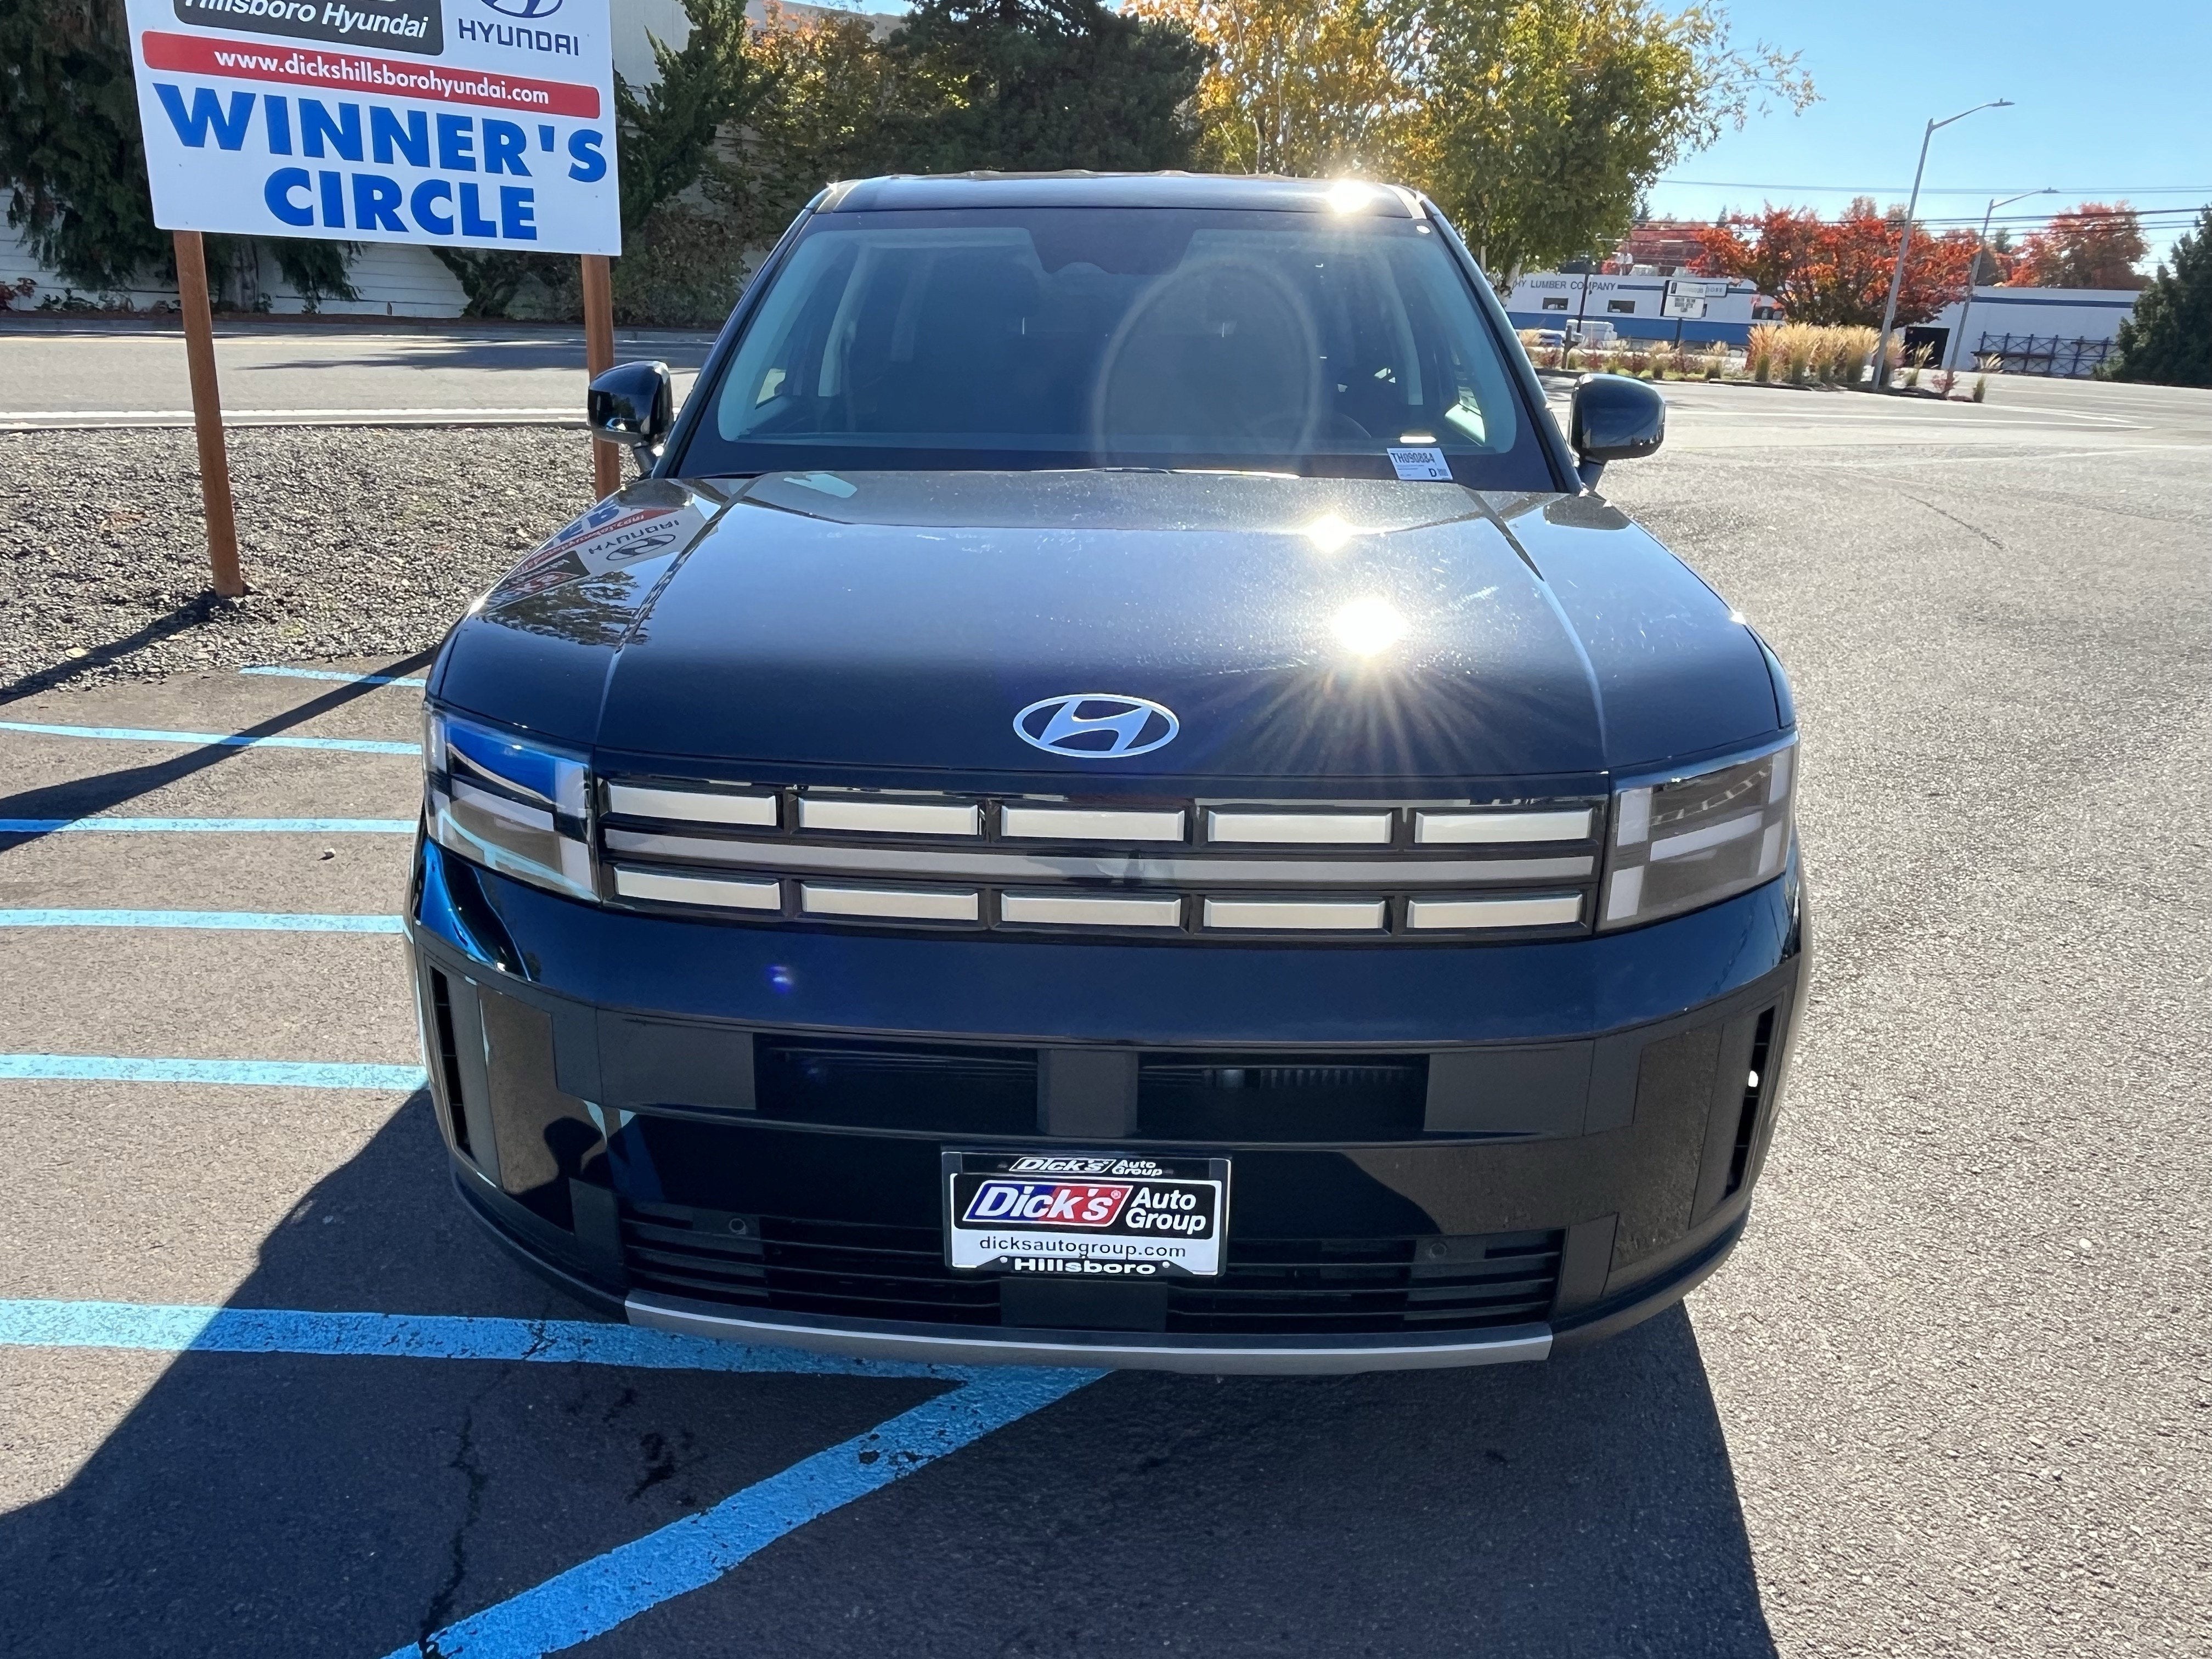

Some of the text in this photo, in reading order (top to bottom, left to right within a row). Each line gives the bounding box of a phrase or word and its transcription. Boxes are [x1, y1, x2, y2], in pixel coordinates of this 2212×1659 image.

[321, 2, 428, 38] Hyundai
[458, 18, 579, 56] HYUNDAI
[214, 50, 549, 105] www.dickshillsborohyundai.com
[152, 83, 607, 183] WINNER'S
[264, 167, 537, 241] CIRCLE
[1531, 280, 1566, 289] LUMBER
[1570, 280, 1616, 290] COPANY
[1428, 467, 1437, 477] D
[1112, 1166, 1163, 1176] Group
[1117, 1160, 1156, 1169] Auto
[975, 1185, 1113, 1221] Dick's
[1131, 1187, 1197, 1211] Auto
[1125, 1210, 1206, 1234] Group
[979, 1236, 1186, 1257] dicksautogroup.com
[1014, 1258, 1156, 1274] Hillsboro
